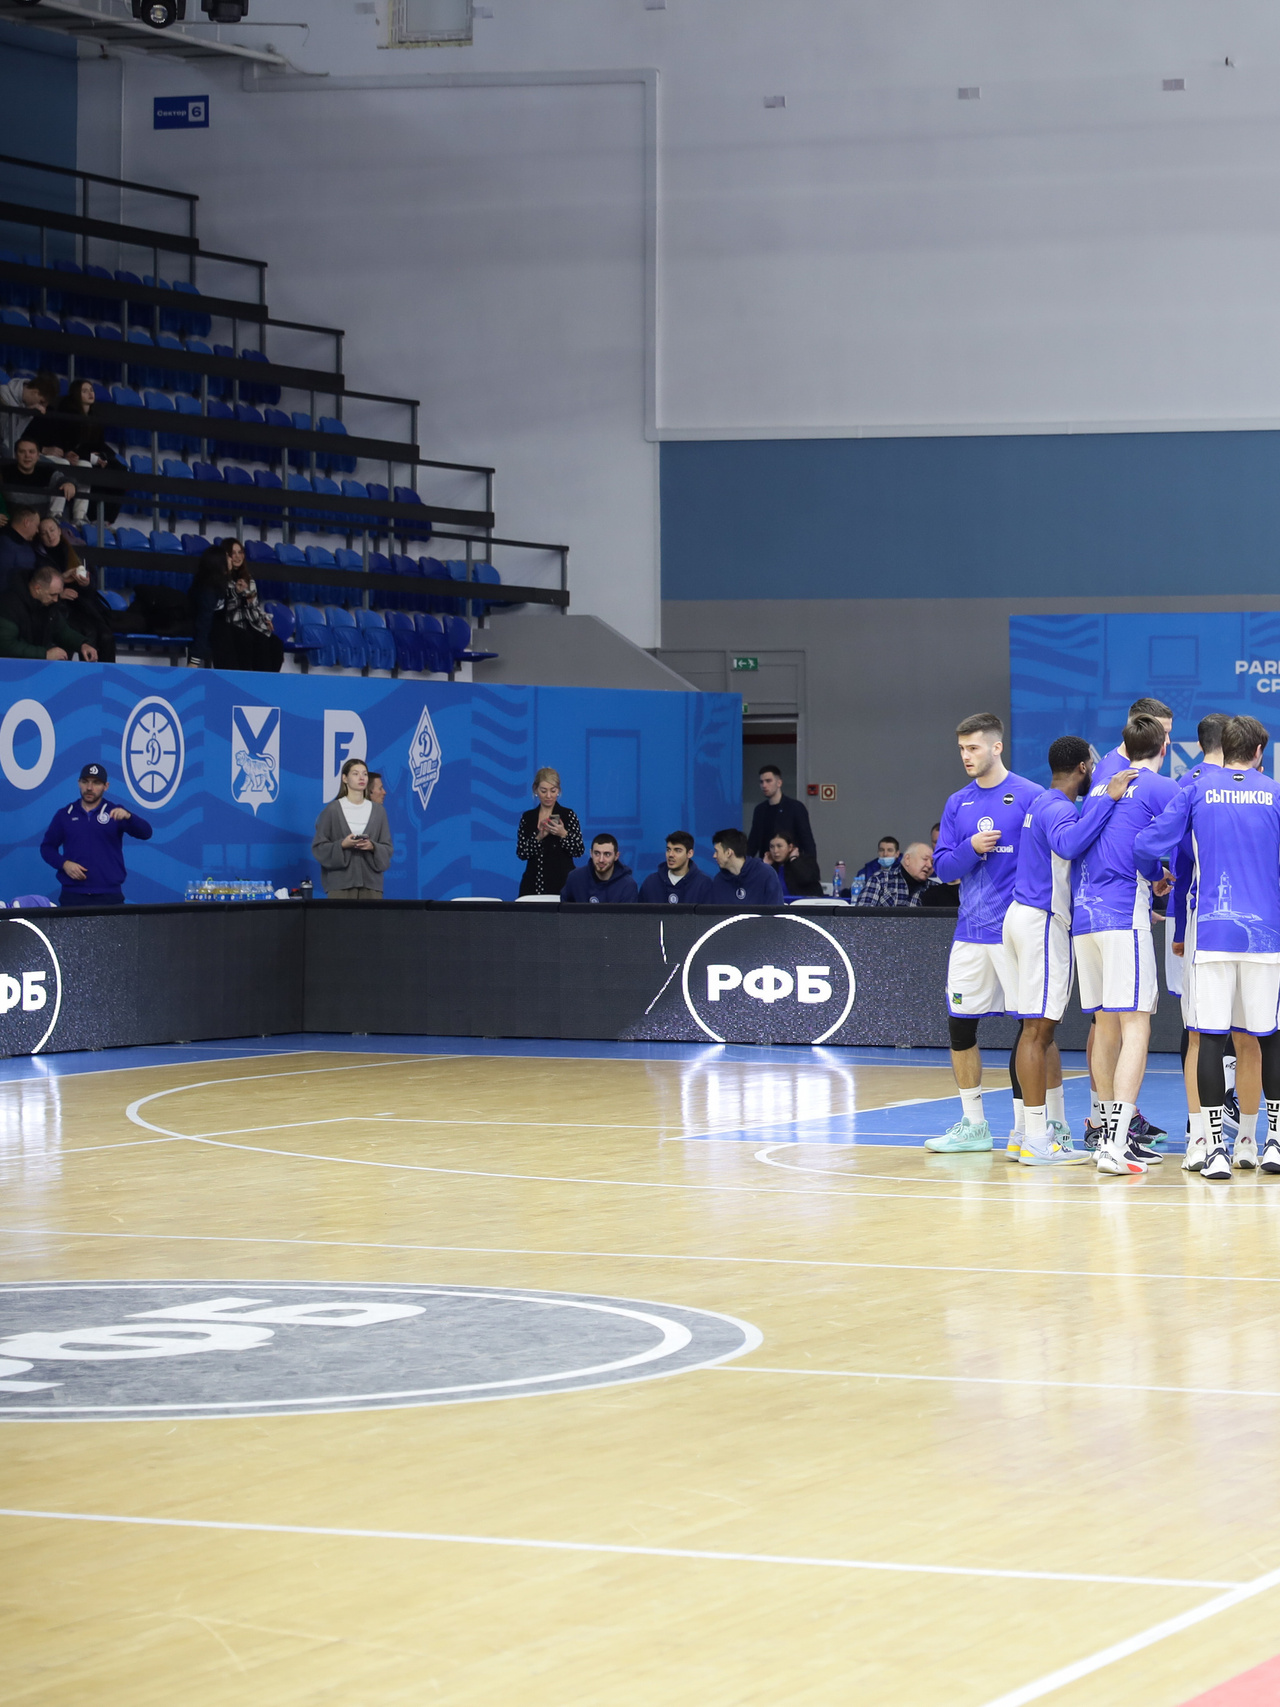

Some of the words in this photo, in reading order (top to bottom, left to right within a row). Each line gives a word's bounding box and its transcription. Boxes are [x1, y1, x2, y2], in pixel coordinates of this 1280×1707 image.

[157, 109, 187, 117] Сектор
[191, 106, 202, 117] 6
[1205, 788, 1273, 806] СЫТНИКОВ
[706, 964, 832, 1003] РФБ
